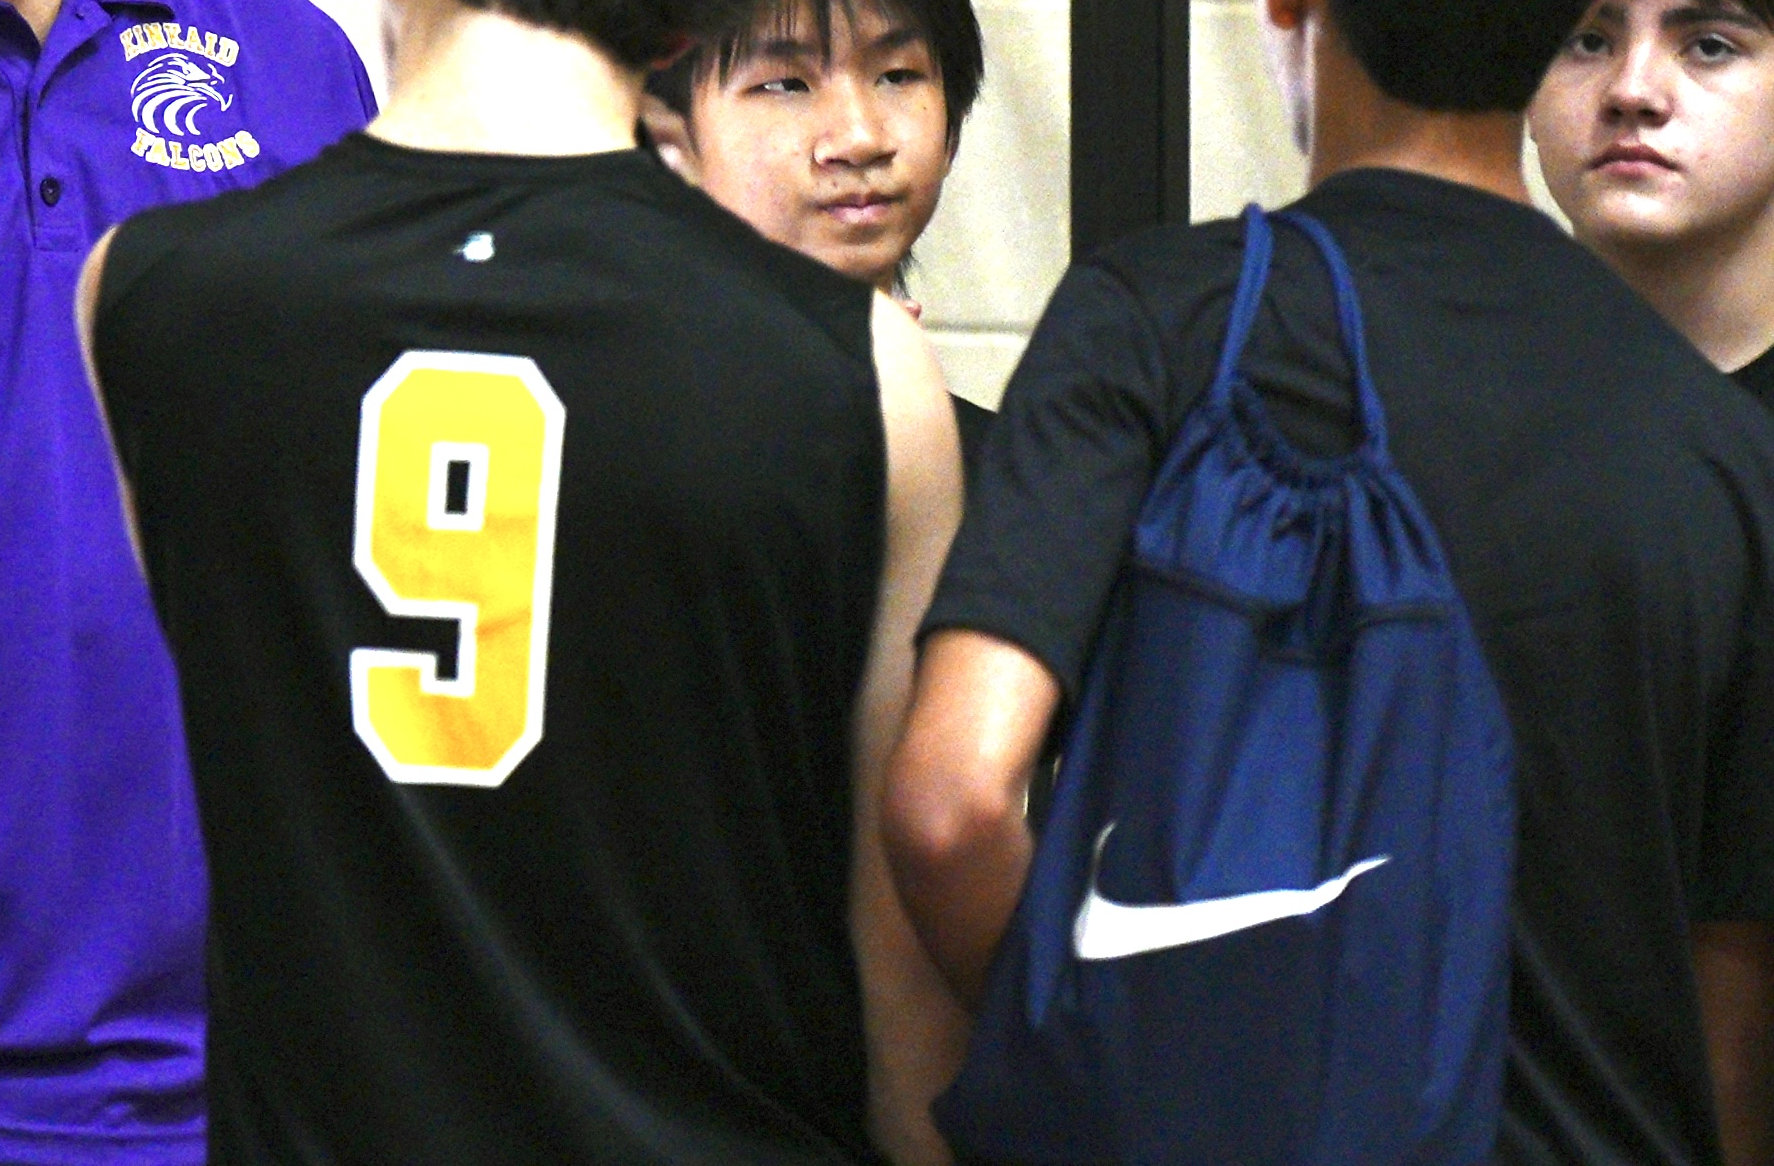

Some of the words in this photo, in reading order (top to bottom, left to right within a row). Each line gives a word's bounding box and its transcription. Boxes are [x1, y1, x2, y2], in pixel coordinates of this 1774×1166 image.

[119, 22, 240, 67] KINKAID
[131, 127, 260, 172] FALCONS
[350, 349, 567, 787] 9
